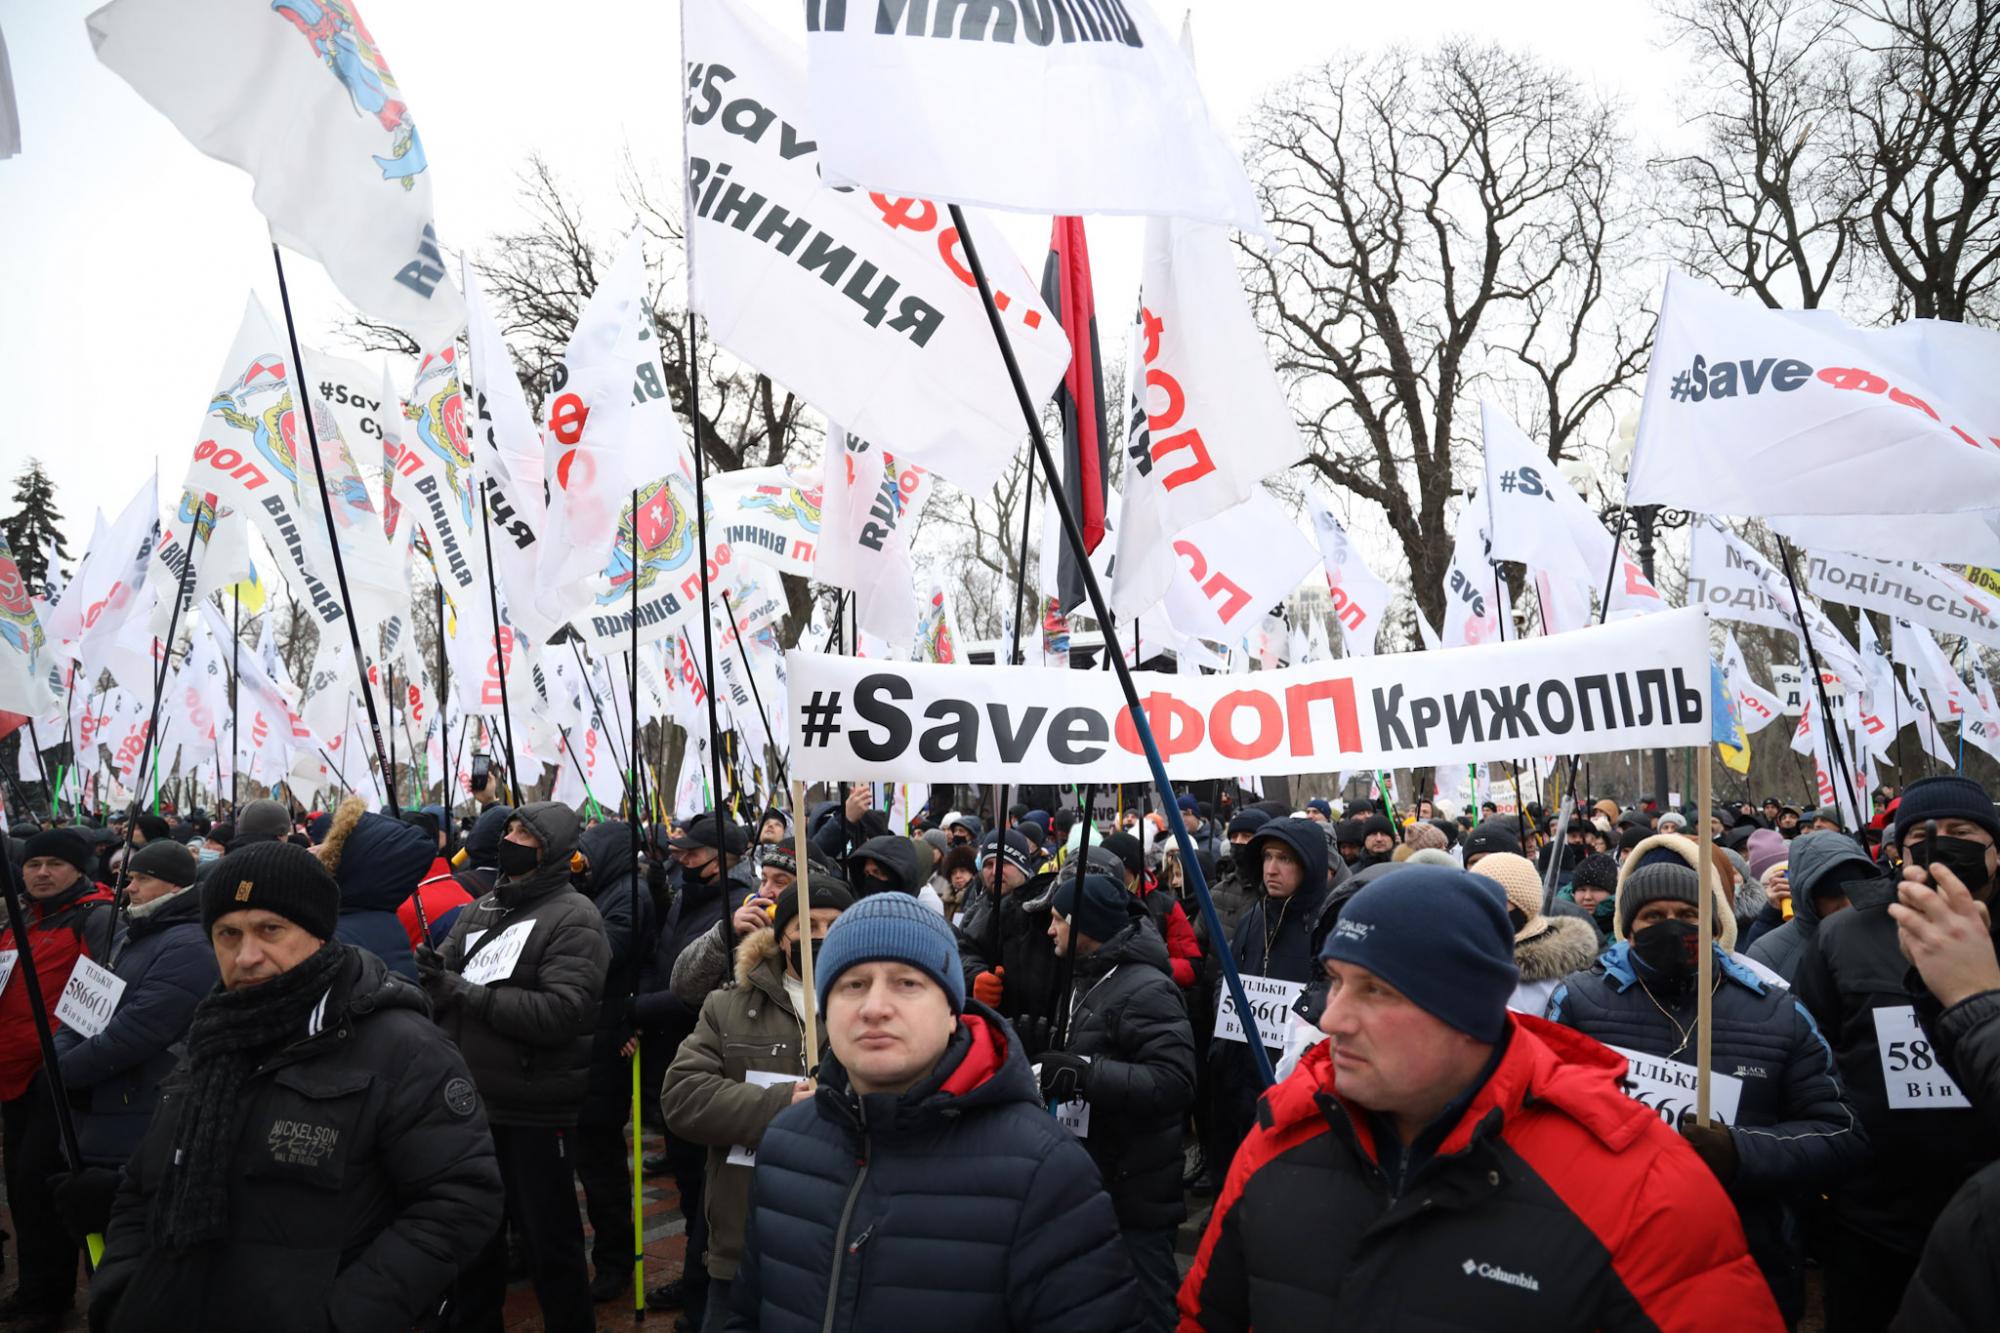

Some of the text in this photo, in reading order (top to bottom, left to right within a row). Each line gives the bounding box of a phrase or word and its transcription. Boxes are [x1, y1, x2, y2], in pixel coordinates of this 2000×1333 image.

[193, 439, 269, 490] ФОП
[415, 475, 473, 588] ВІННИЦЯ
[801, 673, 1364, 765] #SaveФОП
[1004, 844, 1027, 863] UFC
[271, 1120, 339, 1145] NICKELSON
[1478, 1263, 1539, 1291] Columbia
